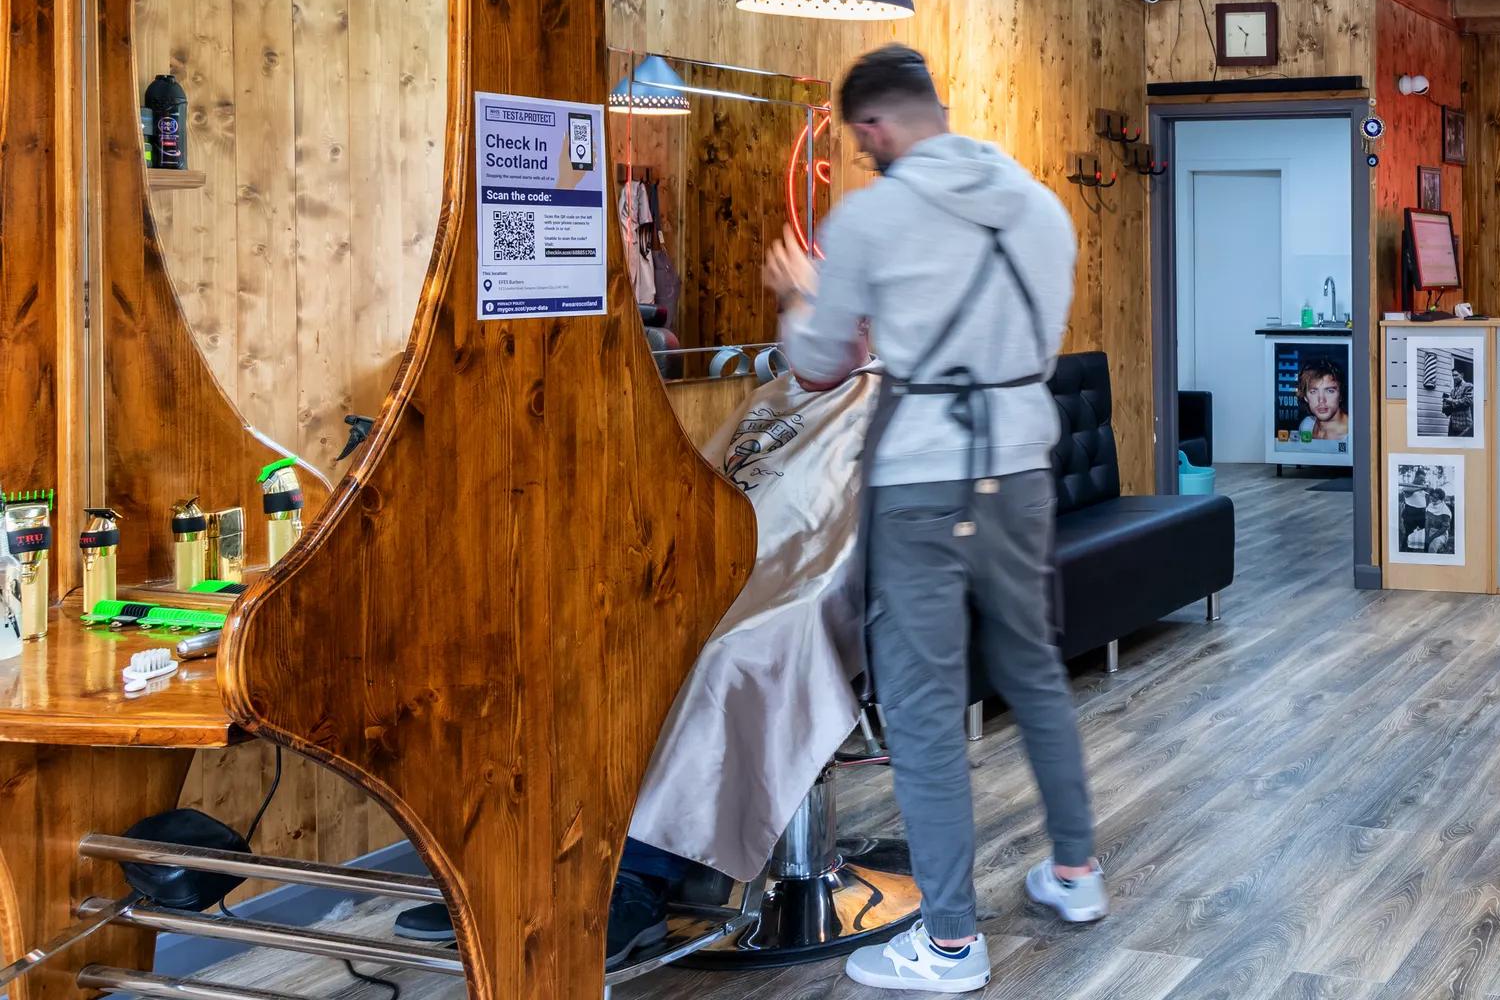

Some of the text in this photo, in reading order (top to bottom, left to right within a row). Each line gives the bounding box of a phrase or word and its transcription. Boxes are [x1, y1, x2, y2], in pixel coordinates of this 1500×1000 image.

[502, 110, 552, 123] TEST&PROTECT
[486, 134, 547, 152] Check In
[486, 153, 548, 170] Scotland
[486, 189, 552, 202] Scan the code:
[1279, 351, 1298, 392] FEEL
[1279, 396, 1298, 407] YOUR
[16, 533, 43, 544] TRU
